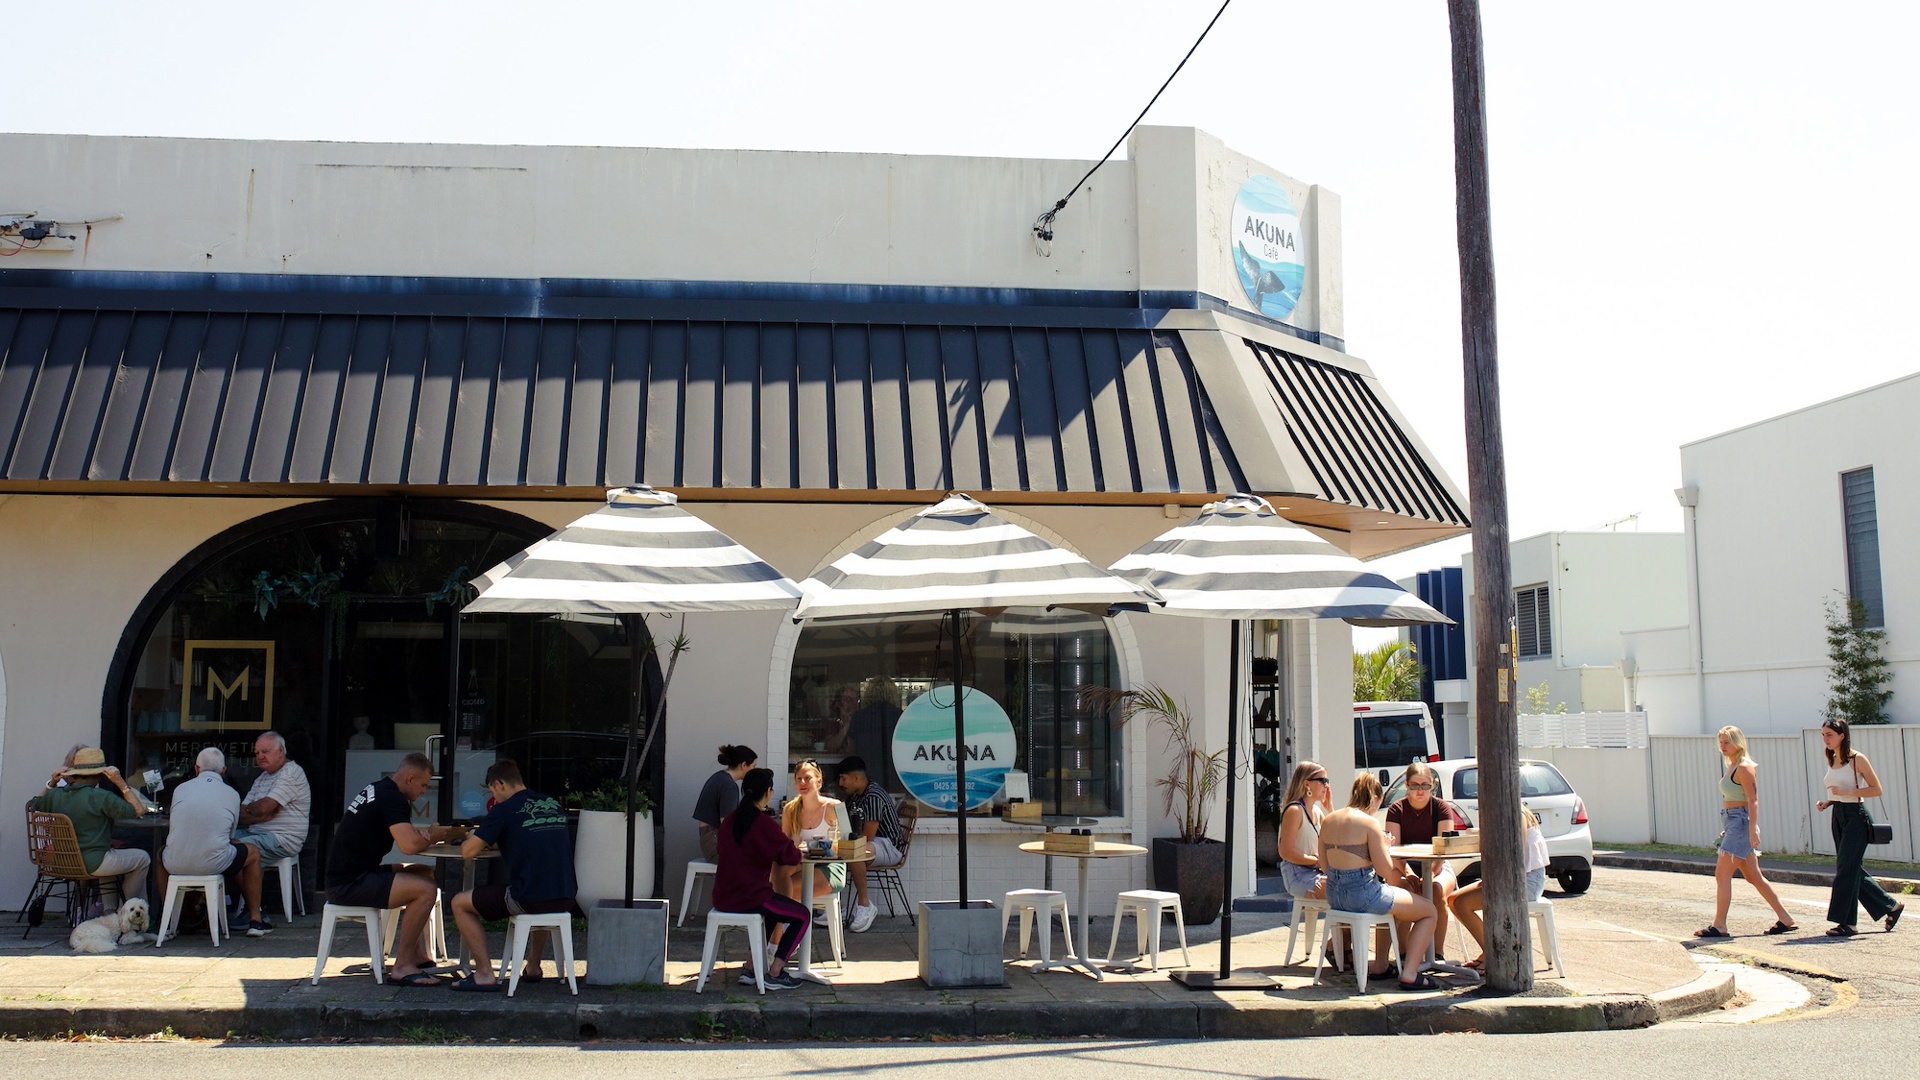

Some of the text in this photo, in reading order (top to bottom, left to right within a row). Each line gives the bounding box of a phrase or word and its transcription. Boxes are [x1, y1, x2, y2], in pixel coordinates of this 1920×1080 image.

[1244, 215, 1296, 252] AKUNA
[206, 665, 249, 700] M
[913, 745, 996, 761] AKUNA
[933, 782, 949, 790] 0425
